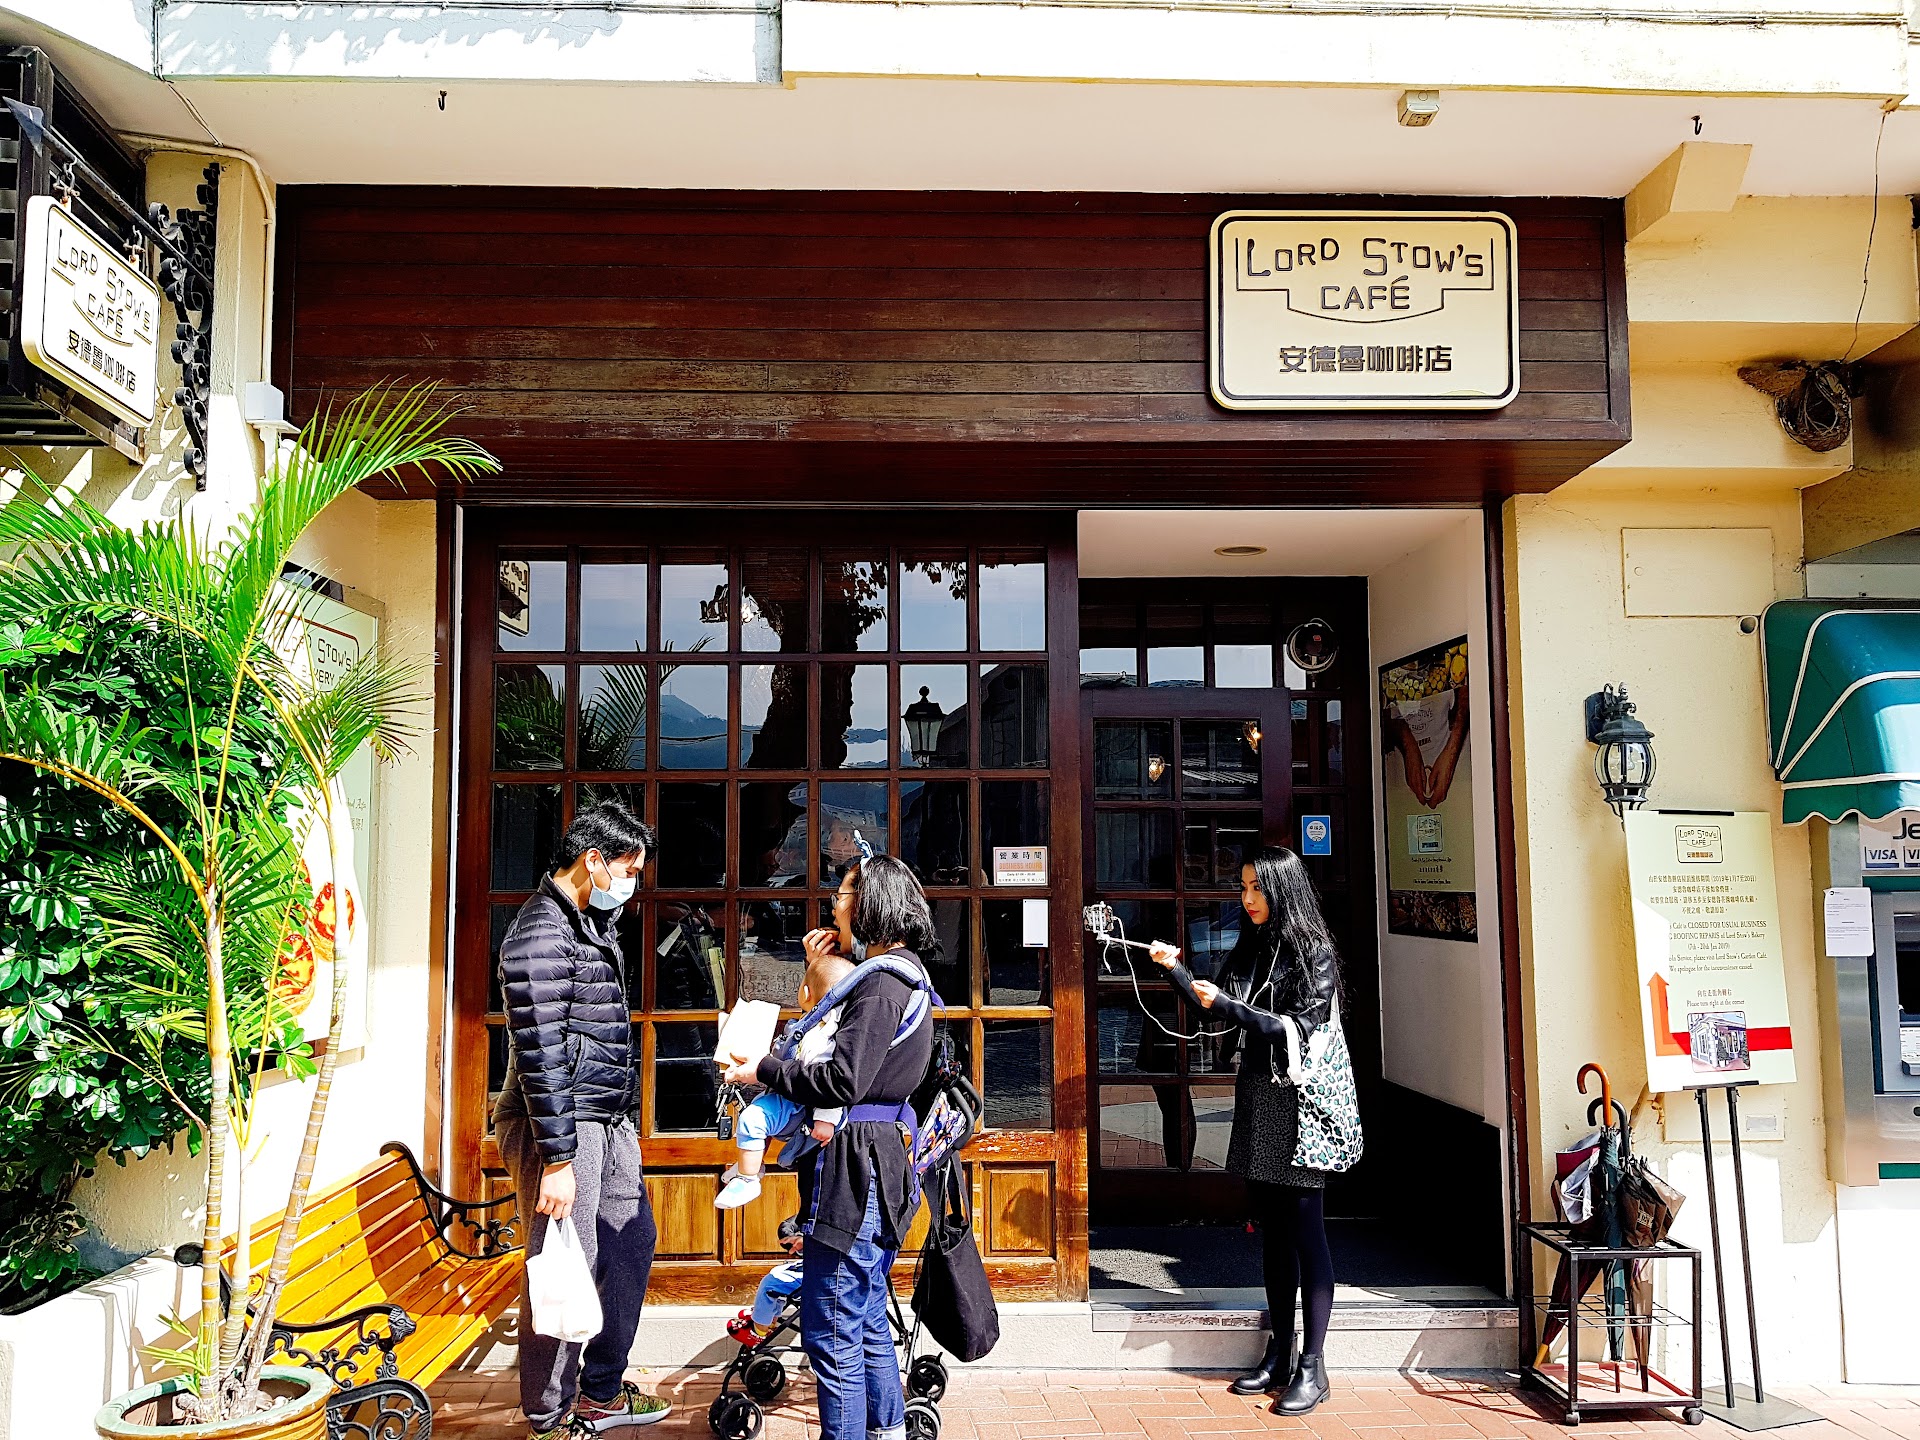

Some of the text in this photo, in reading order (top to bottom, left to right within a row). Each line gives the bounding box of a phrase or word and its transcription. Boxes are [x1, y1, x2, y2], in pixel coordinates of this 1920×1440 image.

[1247, 237, 1484, 277] LORD STOW'S
[56, 229, 151, 331] LORD STOW'S
[1320, 275, 1411, 310] CAFÉ
[87, 293, 124, 338] CAFÉ
[67, 329, 136, 394] 安德魯咖啡店
[1279, 345, 1453, 372] 安德魯咖啡店
[317, 638, 352, 672] STOW'S
[301, 664, 335, 686] BKERY
[999, 851, 1042, 860] 營業時間
[1868, 849, 1898, 860] VISA
[1740, 920, 1767, 928] BUSINESS
